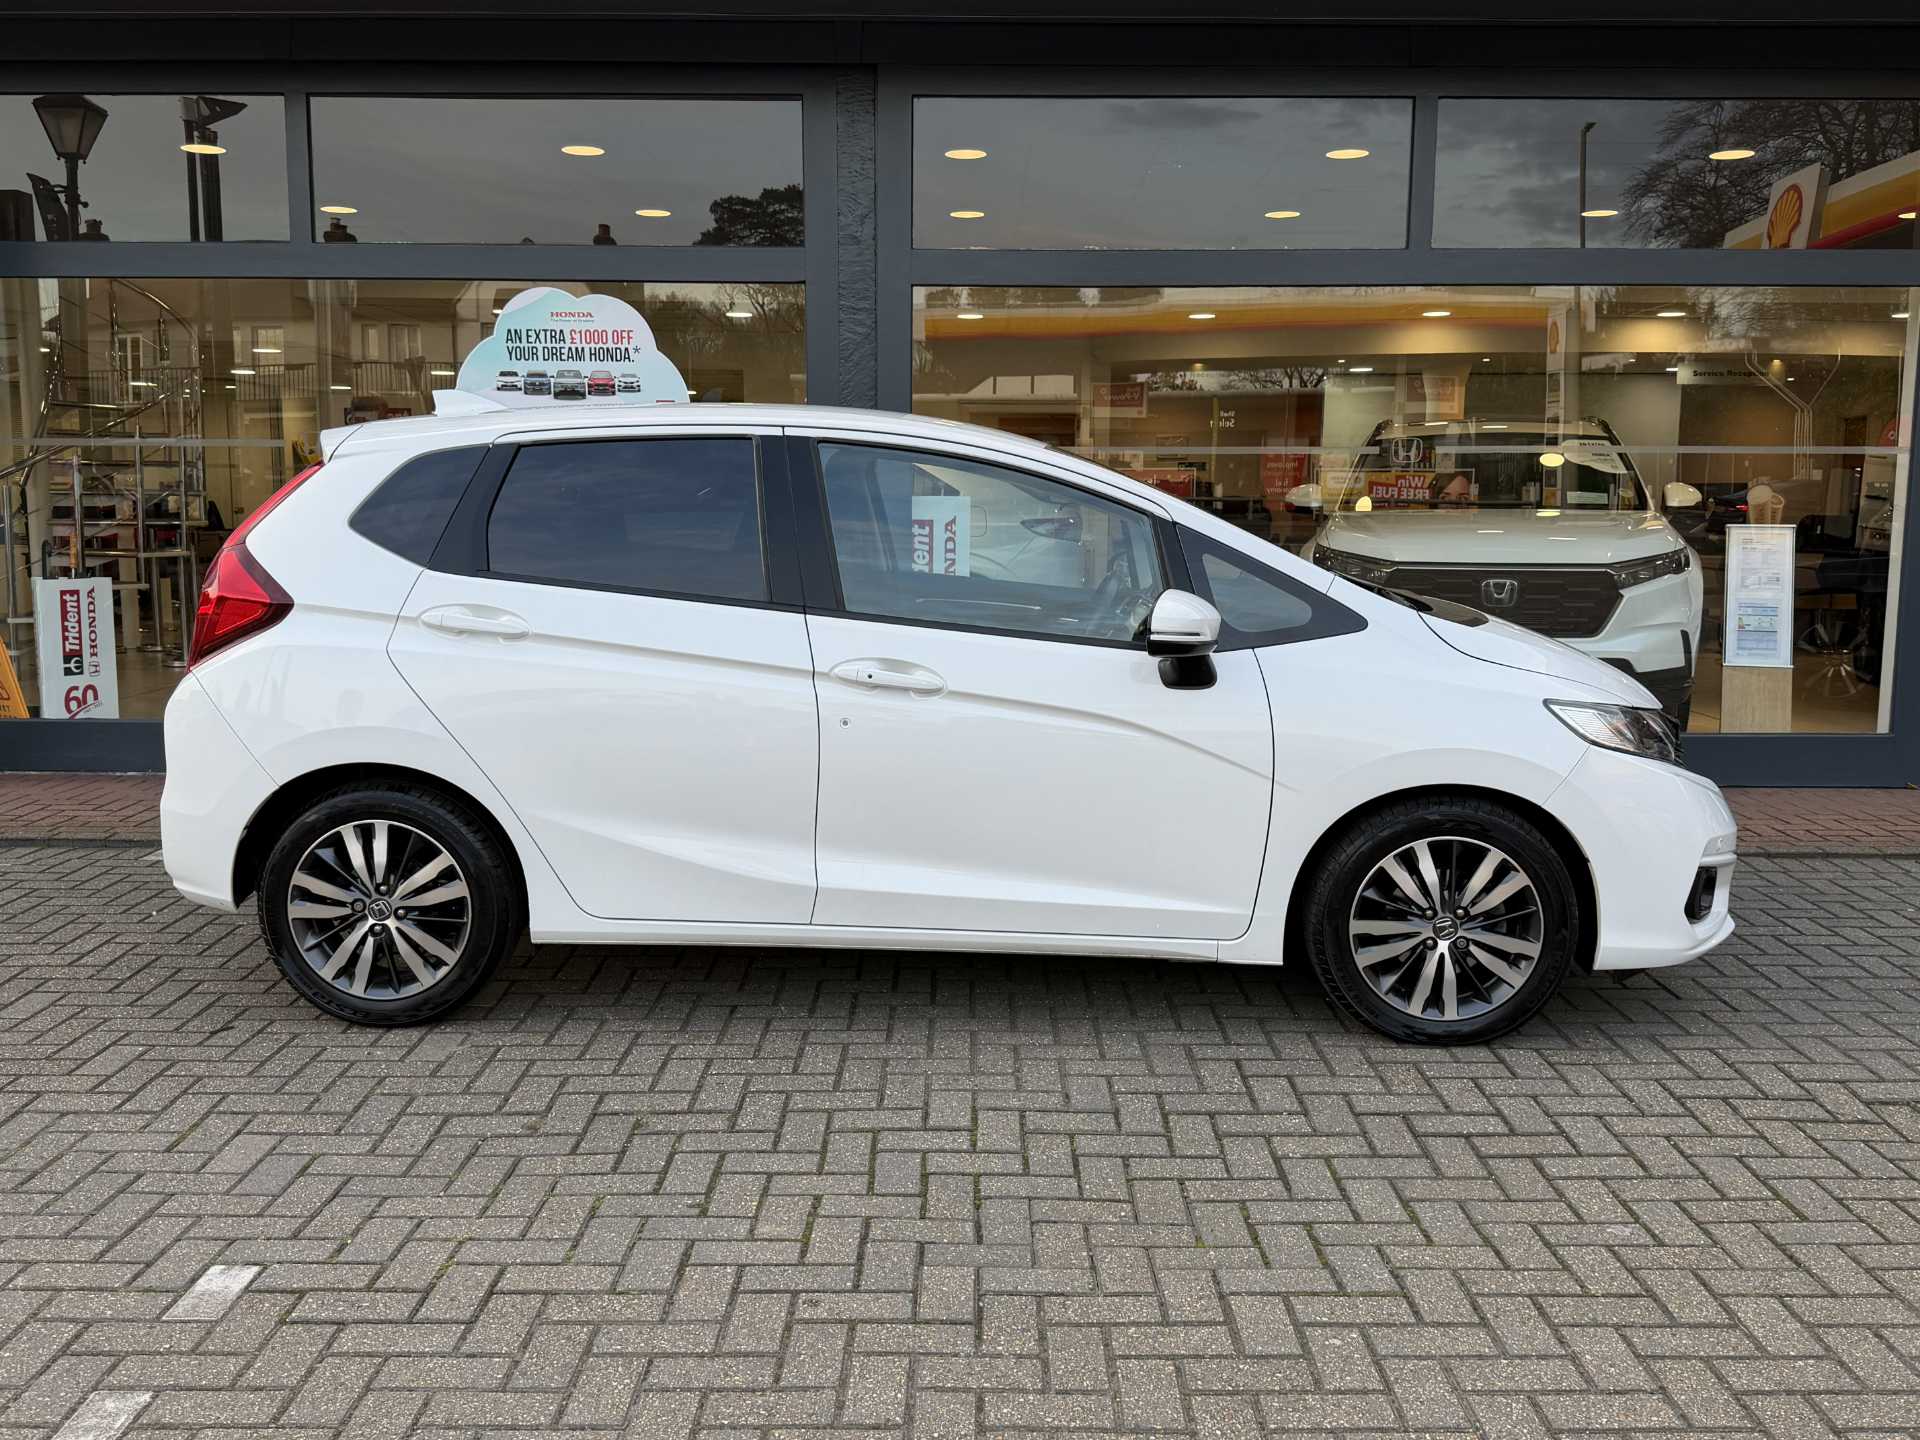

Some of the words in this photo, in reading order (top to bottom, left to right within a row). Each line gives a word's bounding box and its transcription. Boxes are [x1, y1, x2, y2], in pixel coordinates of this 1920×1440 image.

[505, 329, 522, 344] AN
[526, 329, 566, 344] EXTRA
[569, 329, 609, 345] £1000
[611, 330, 634, 345] OFF
[506, 346, 539, 361] YOUR
[542, 346, 585, 362] DREAM
[63, 593, 80, 652] Trident
[87, 586, 98, 658] HONDA
